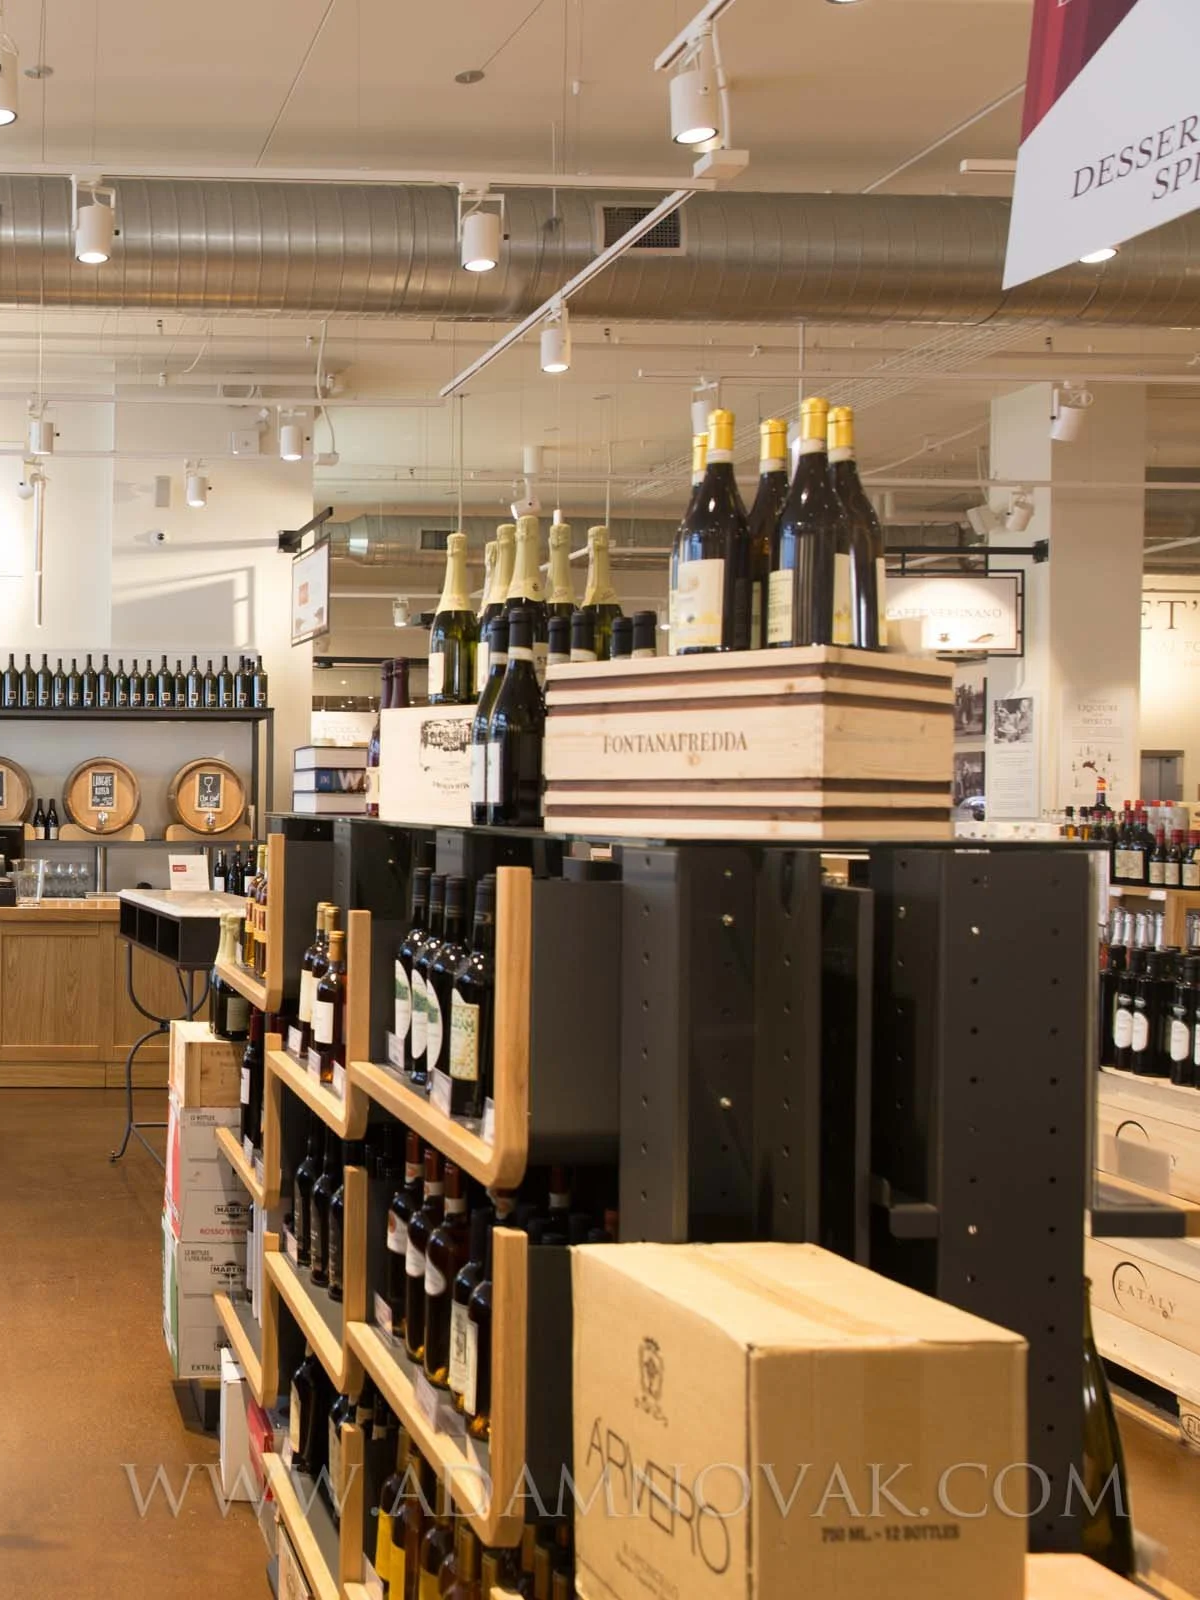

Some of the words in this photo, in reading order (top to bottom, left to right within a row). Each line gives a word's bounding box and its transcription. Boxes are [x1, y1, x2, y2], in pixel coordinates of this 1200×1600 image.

[604, 731, 749, 754] FONTANAFREDDA
[1117, 1280, 1178, 1315] EATALY
[191, 1364, 216, 1372] EXTRA
[903, 1523, 961, 1541] BOTTLES
